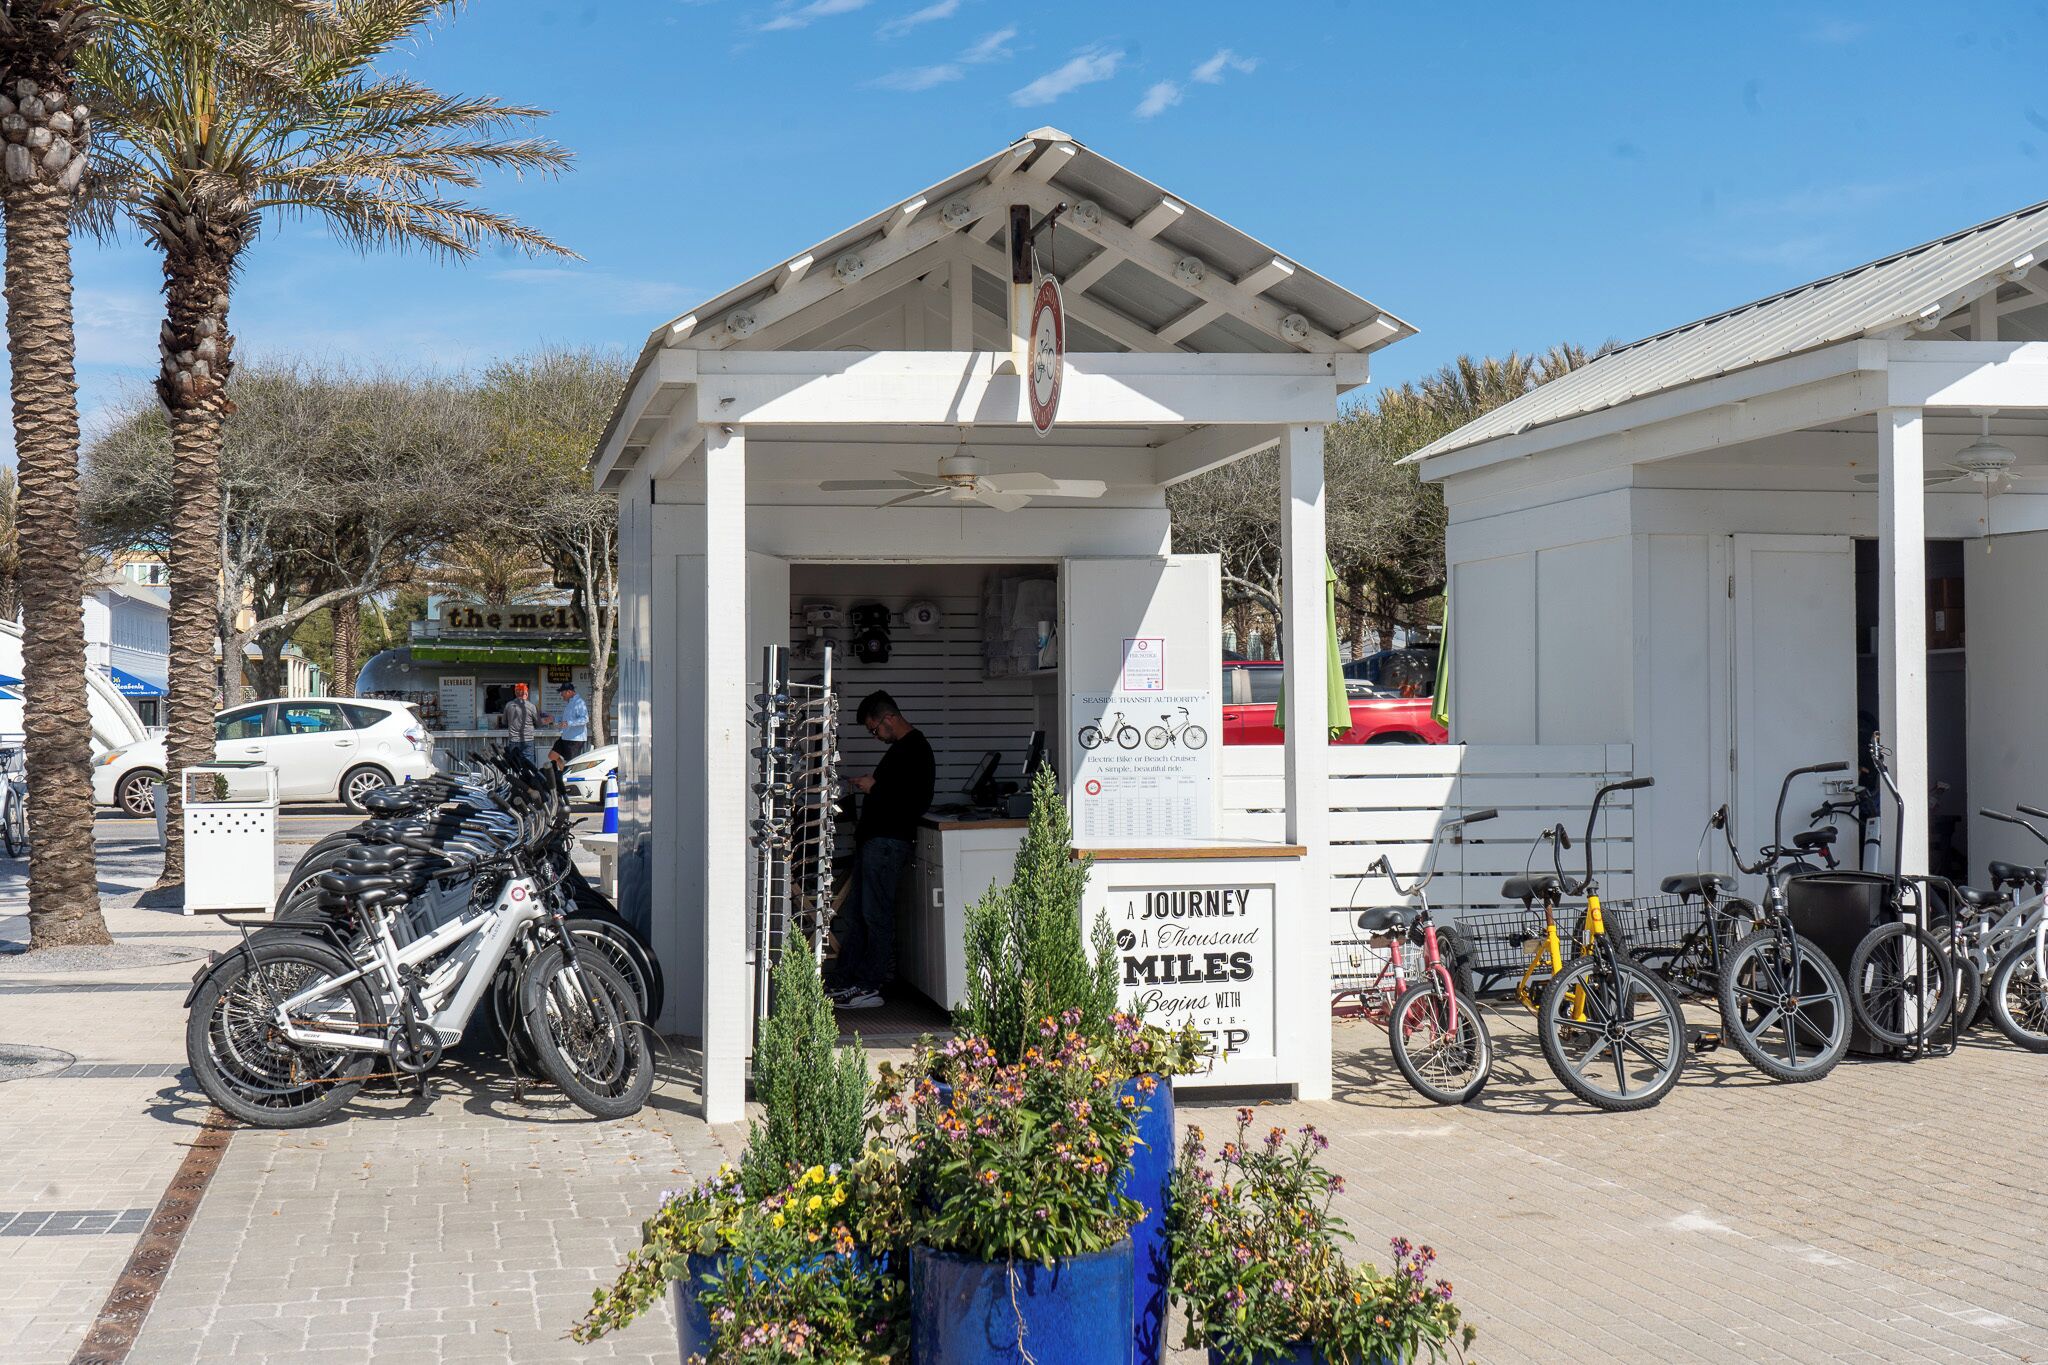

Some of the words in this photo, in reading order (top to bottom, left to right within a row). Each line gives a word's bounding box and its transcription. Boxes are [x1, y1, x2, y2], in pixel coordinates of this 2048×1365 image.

[447, 607, 502, 628] the
[1082, 696, 1117, 704] SEASIDE
[1119, 696, 1152, 704] TRANSIT
[1153, 695, 1200, 704] AUTHORITY
[1127, 901, 1134, 920] A
[1140, 889, 1250, 920] JOURNEY
[1118, 931, 1135, 950] of
[1141, 929, 1148, 948] A
[1157, 922, 1260, 949] Thousand
[1122, 951, 1254, 986] MILES
[1140, 988, 1211, 1017] Begins
[1215, 991, 1241, 1009] WITH
